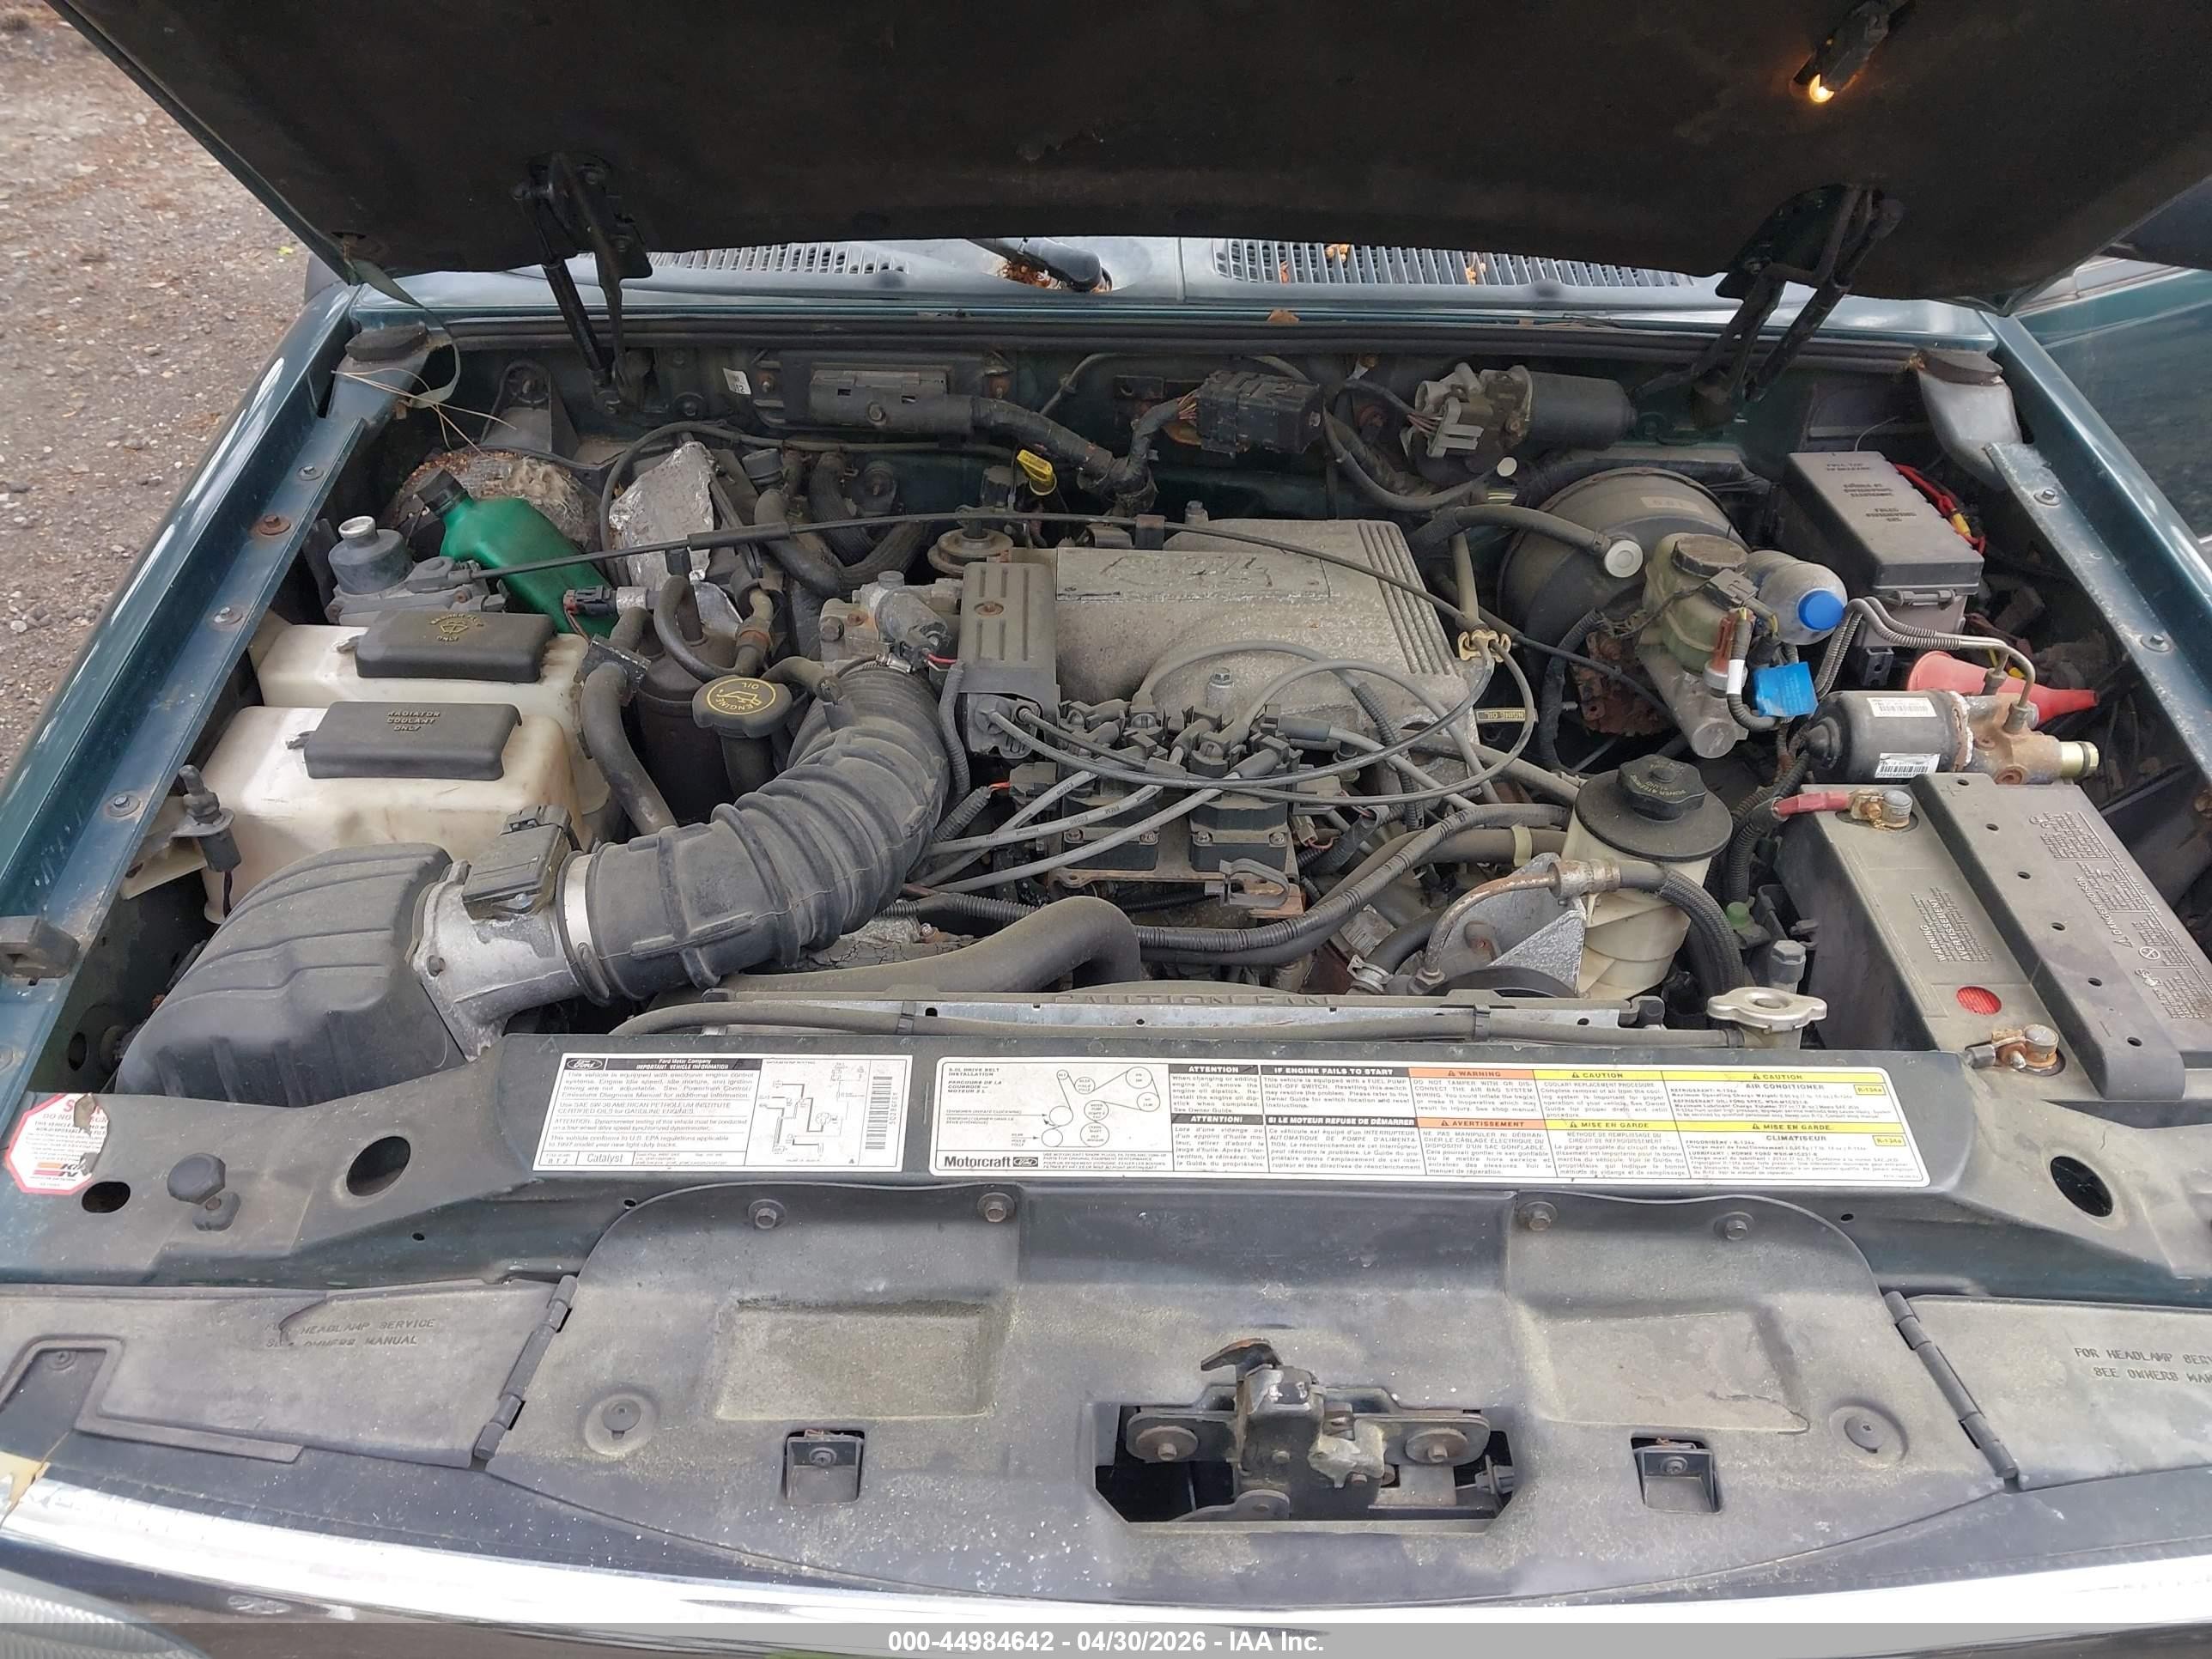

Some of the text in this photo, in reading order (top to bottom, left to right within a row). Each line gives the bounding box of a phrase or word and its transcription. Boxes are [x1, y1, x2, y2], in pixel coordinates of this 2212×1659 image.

[716, 698, 754, 710] ENGINE
[1919, 925, 1947, 962] WARNING
[586, 1153, 623, 1163] Catalyst
[944, 1156, 1010, 1167] Motorcraft
[380, 1319, 435, 1330] SERVICE
[366, 1335, 418, 1346] MANUAL
[2075, 1347, 2100, 1358] FOR
[2106, 1349, 2172, 1362] HEADLAMP
[2094, 1367, 2120, 1378] SEE
[2127, 1369, 2179, 1382] OWNERS
